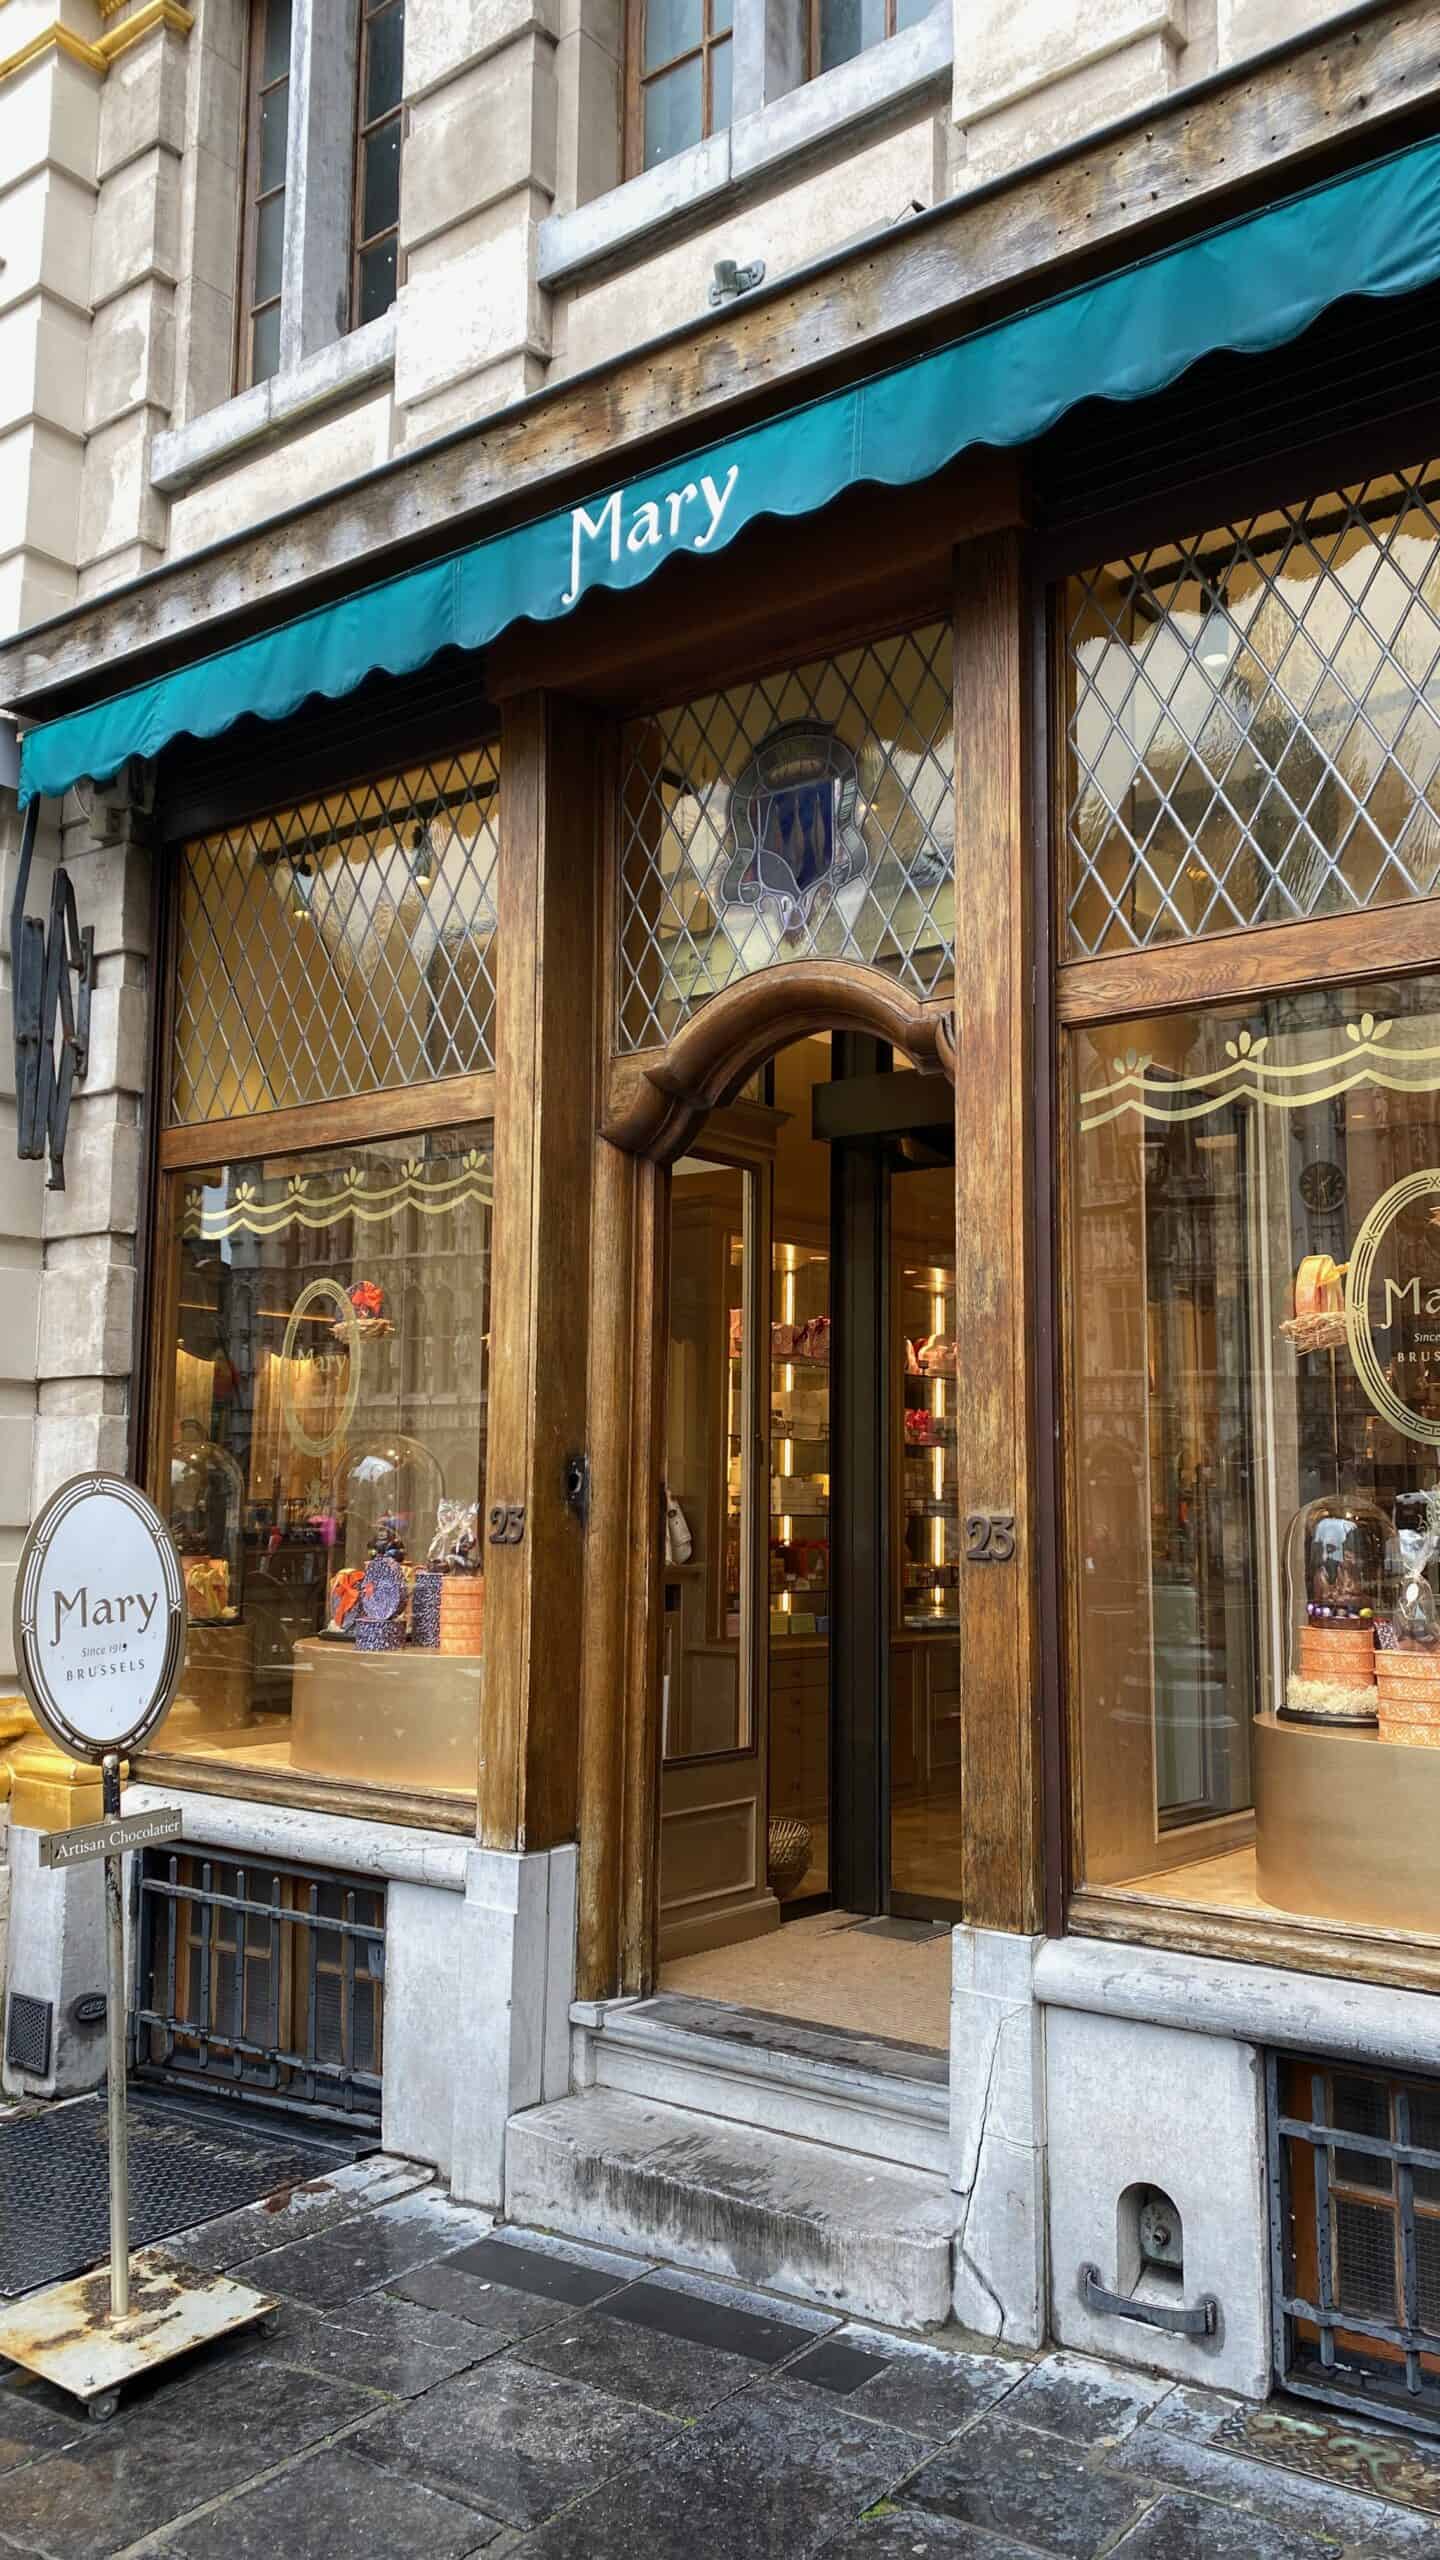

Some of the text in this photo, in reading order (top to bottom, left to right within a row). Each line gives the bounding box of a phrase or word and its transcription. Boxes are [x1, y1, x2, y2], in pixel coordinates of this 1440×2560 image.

[561, 464, 739, 605] Mary
[50, 1586, 158, 1647] Mary
[66, 1658, 145, 1681] BRUSSELS
[81, 1647, 106, 1657] Since
[56, 1820, 180, 1860] Artisan Chocolatier
